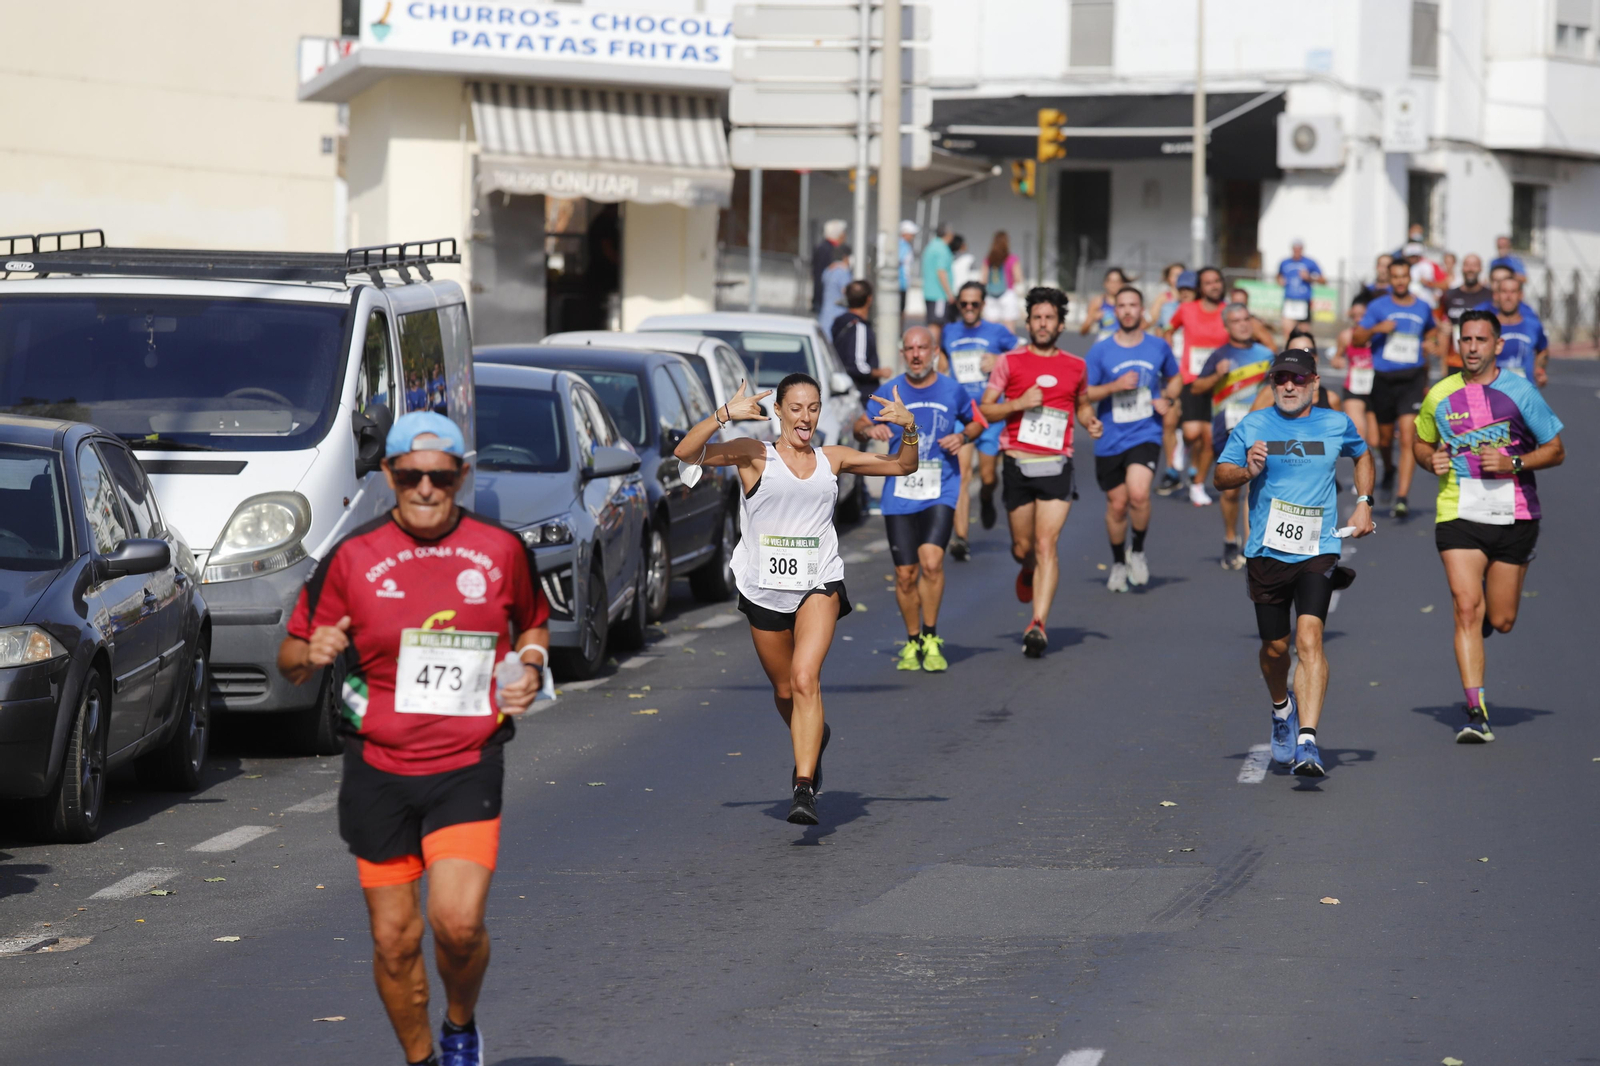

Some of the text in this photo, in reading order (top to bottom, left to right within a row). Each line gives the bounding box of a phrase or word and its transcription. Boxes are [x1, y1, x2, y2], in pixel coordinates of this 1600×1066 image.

[407, 2, 560, 28] CHURROS
[452, 30, 720, 63] PATATAS FRITAS
[1029, 419, 1052, 437] 513
[903, 475, 924, 488] 234
[1281, 503, 1300, 515] VUELTA
[1276, 521, 1304, 541] 488
[770, 538, 790, 547] VUELTA
[790, 539, 796, 547] A
[796, 540, 815, 548] HUELVA
[769, 557, 797, 575] 308
[416, 664, 462, 690] 473
